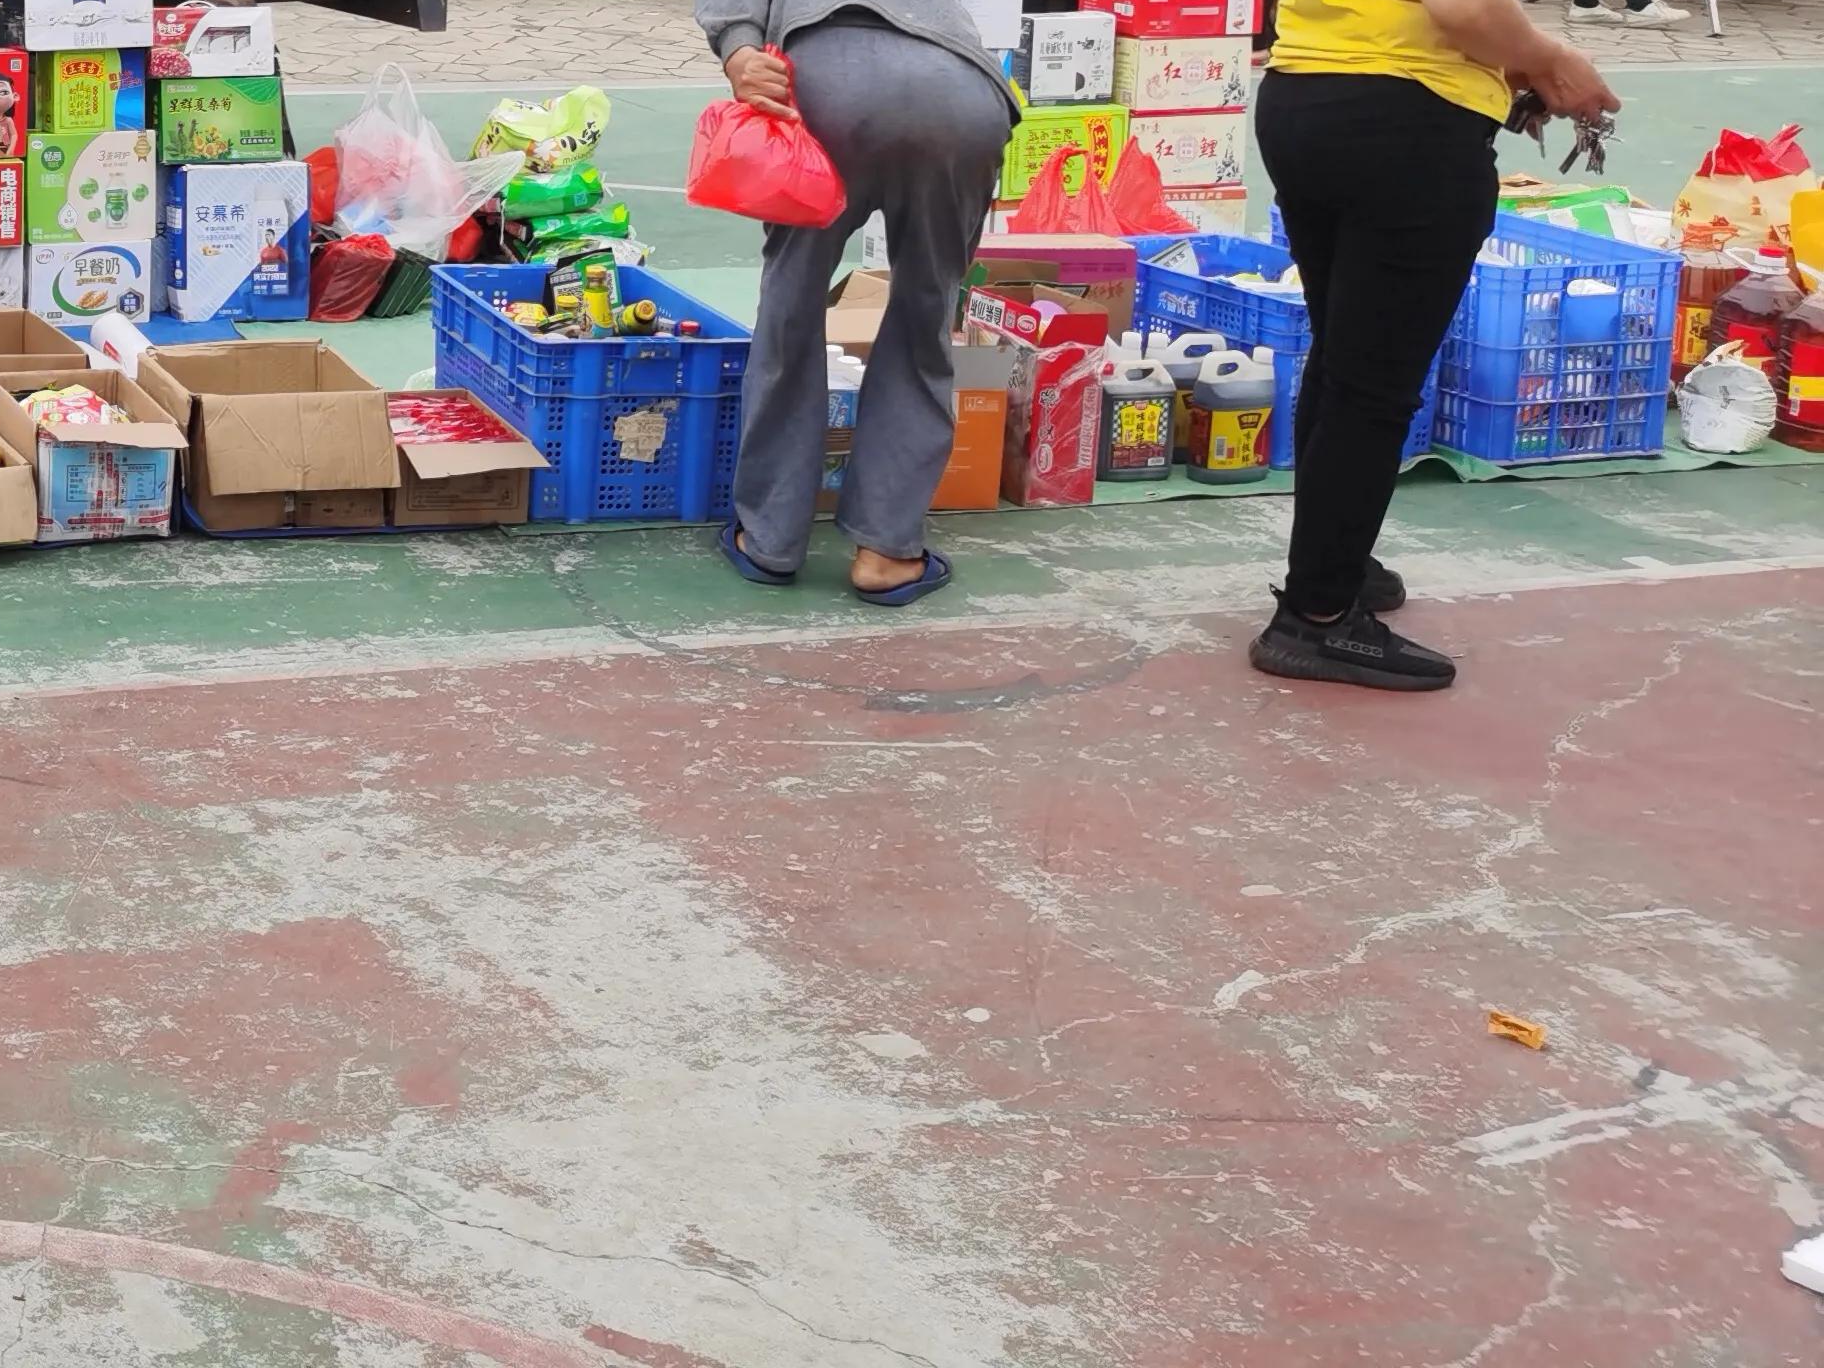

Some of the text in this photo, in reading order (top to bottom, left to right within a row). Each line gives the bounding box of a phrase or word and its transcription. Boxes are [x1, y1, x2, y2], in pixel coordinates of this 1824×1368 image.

[68, 63, 99, 74] 王老吉
[168, 96, 232, 113] 星群夏桑菊
[0, 168, 18, 239] 电商销售
[194, 204, 245, 224] 安慕希
[74, 257, 120, 277] 早餐奶
